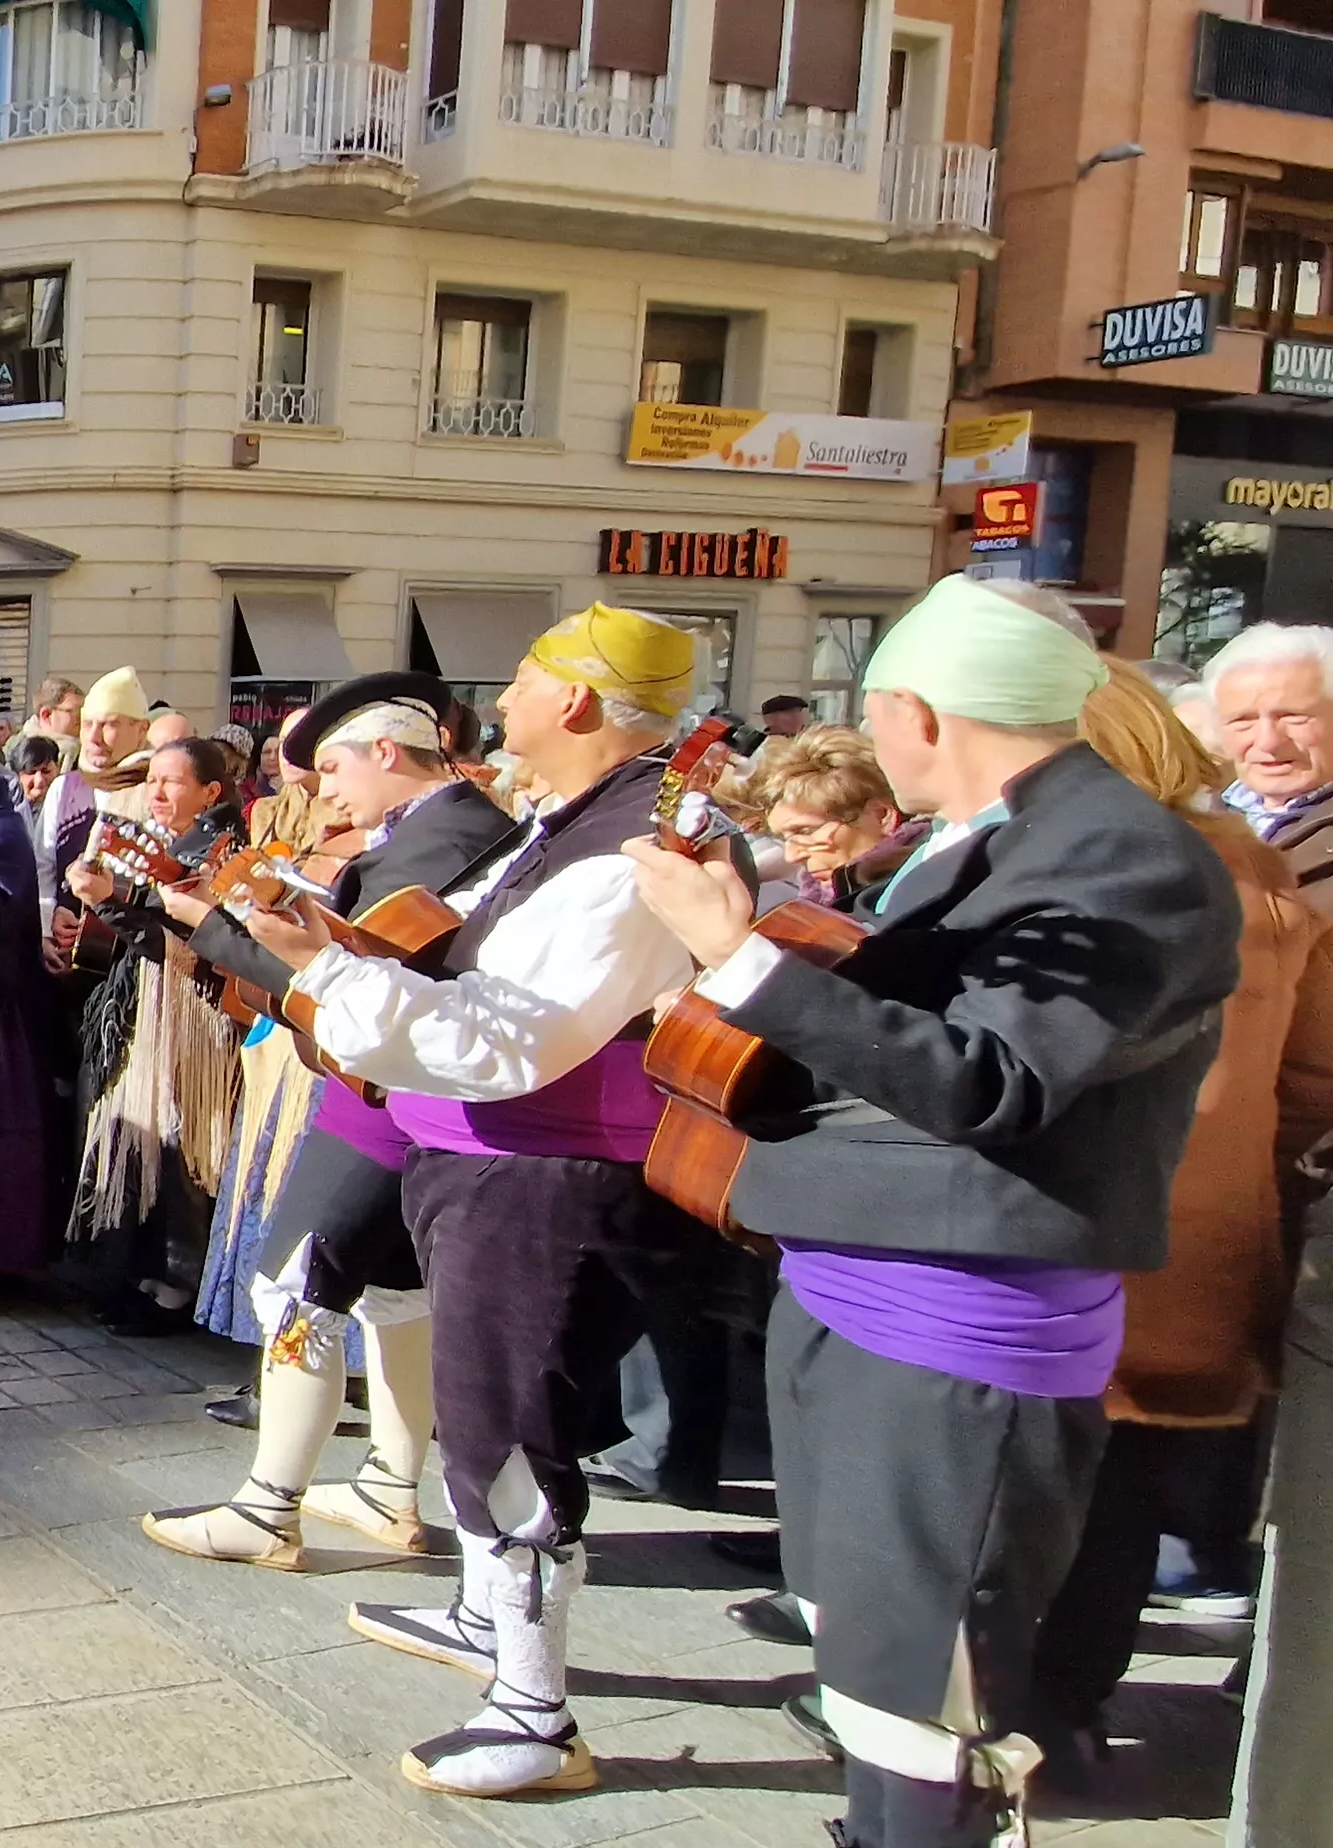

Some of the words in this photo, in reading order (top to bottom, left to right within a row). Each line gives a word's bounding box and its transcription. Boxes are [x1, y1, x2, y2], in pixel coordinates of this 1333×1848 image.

[1103, 298, 1203, 350] DUVISA
[1102, 338, 1202, 364] ASESORES
[1273, 343, 1333, 380] DUVI
[653, 406, 697, 424] Compra
[701, 412, 749, 427] Alquiler
[806, 441, 908, 467] Santaliestra
[972, 537, 1018, 550] ABACOS
[974, 524, 1030, 538] TABACOS
[608, 528, 643, 574] LA
